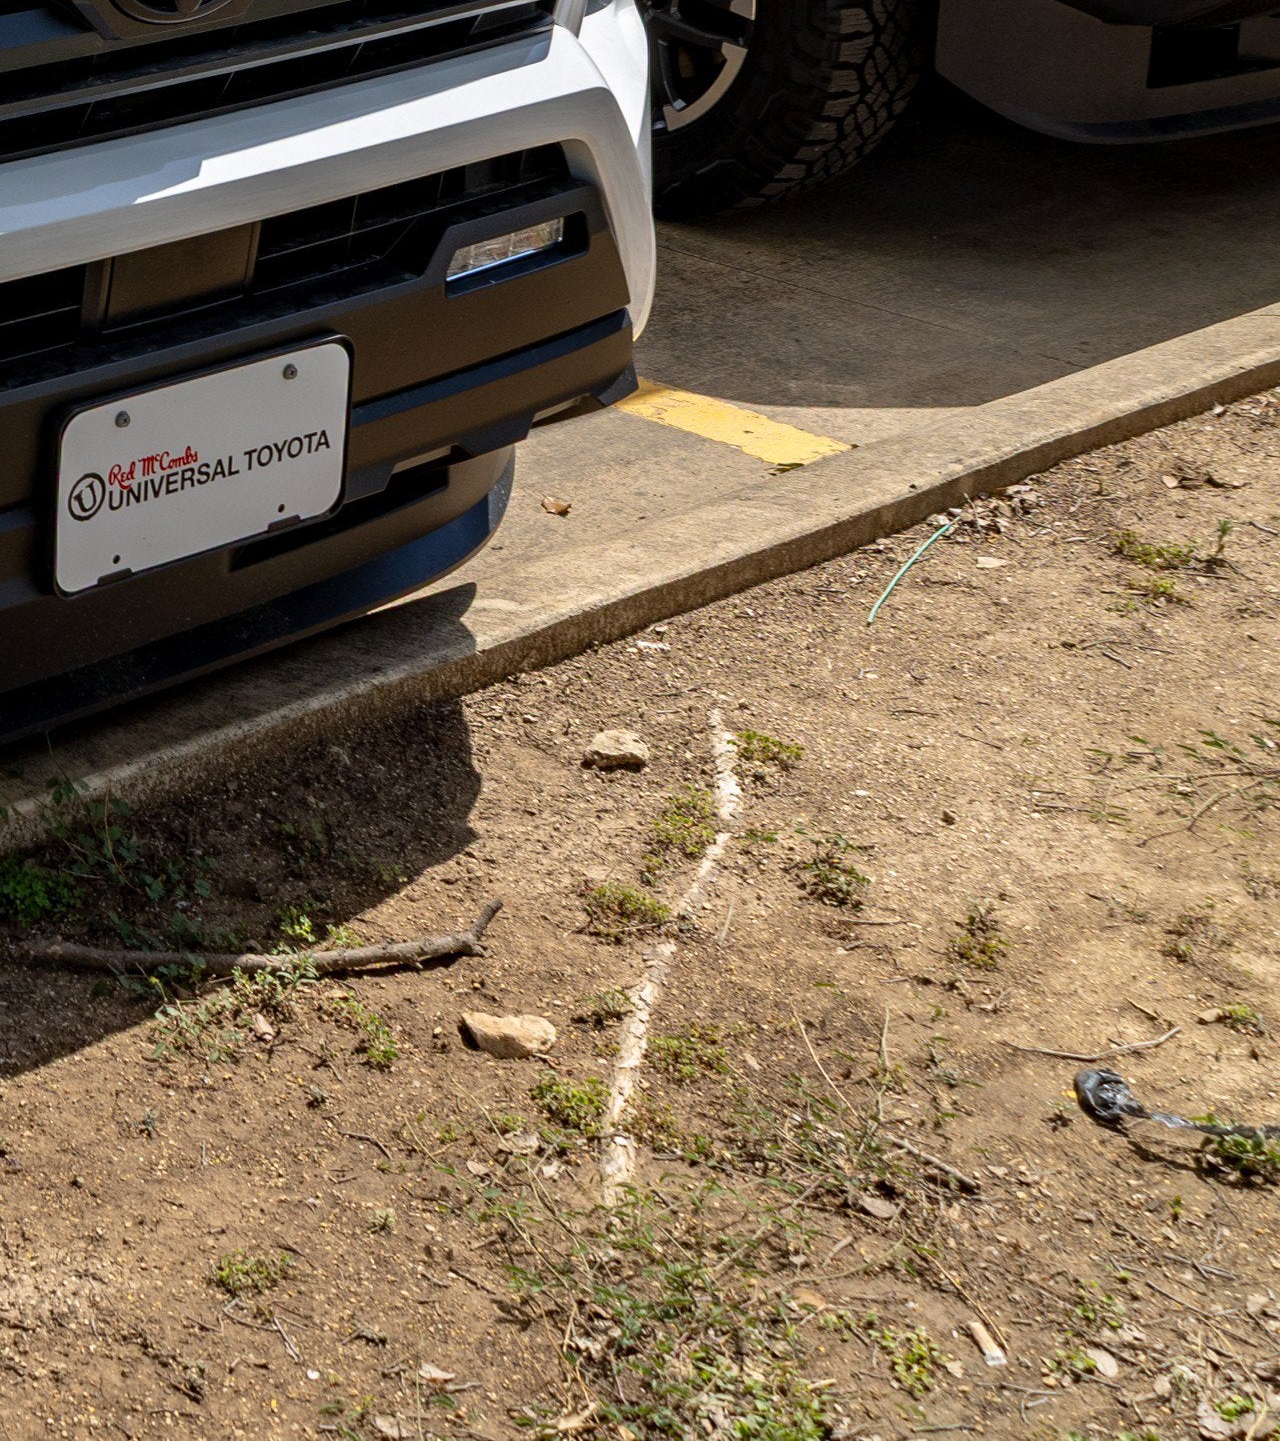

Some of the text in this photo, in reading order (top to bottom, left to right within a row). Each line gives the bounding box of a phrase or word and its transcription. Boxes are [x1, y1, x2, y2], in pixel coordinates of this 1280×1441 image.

[108, 446, 198, 490] Red McCombs
[108, 429, 330, 511] UNIVERSAL TOYOTA
